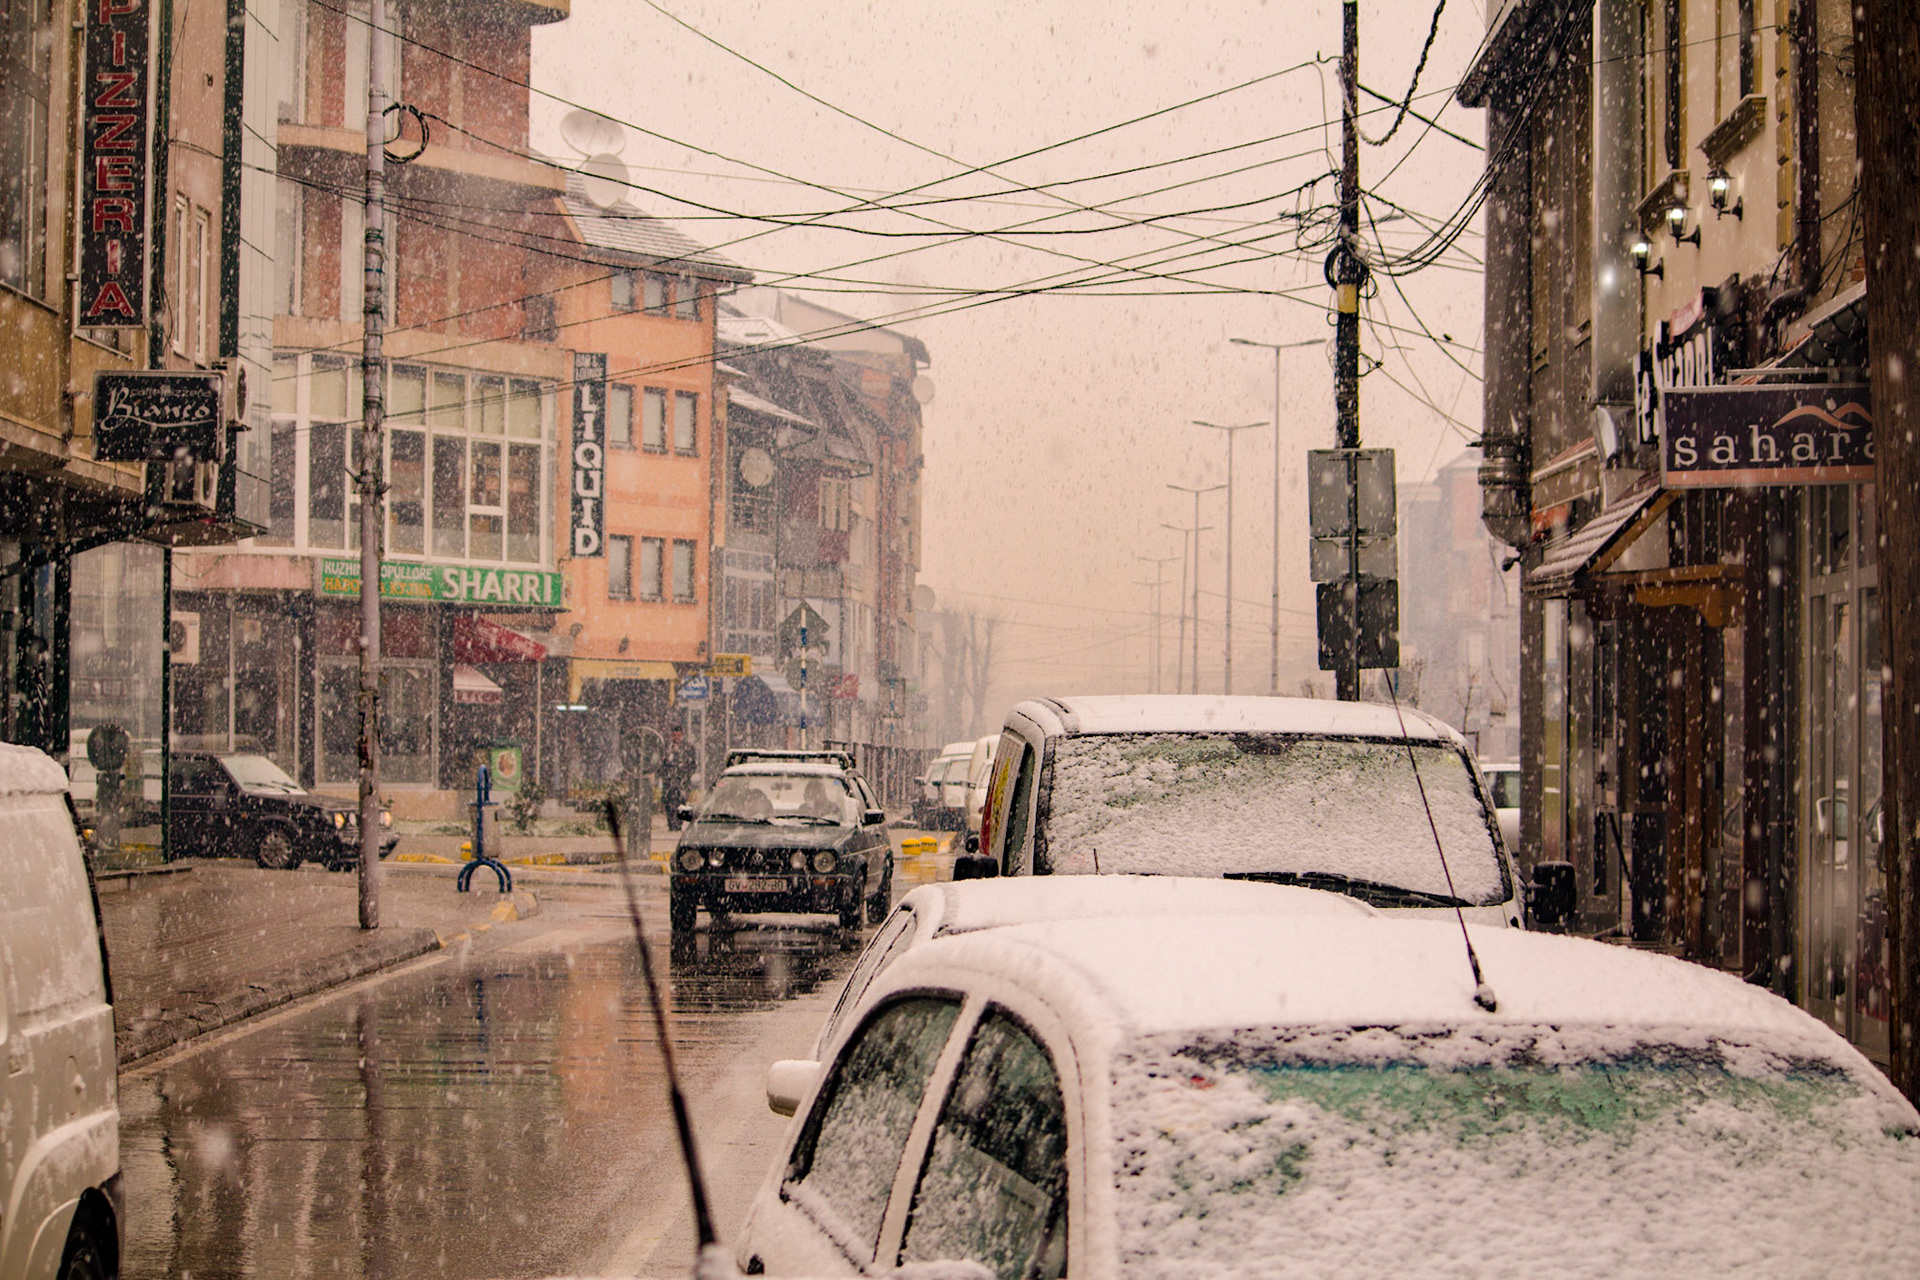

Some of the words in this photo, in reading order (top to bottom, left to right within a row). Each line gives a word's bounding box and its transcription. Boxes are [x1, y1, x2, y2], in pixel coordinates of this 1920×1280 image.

[89, 0, 137, 317] PIZZERIA
[100, 386, 215, 431] Bianco
[575, 385, 602, 554] LIQUID
[380, 565, 433, 580] OPULLORE
[442, 567, 551, 603] SHARRI
